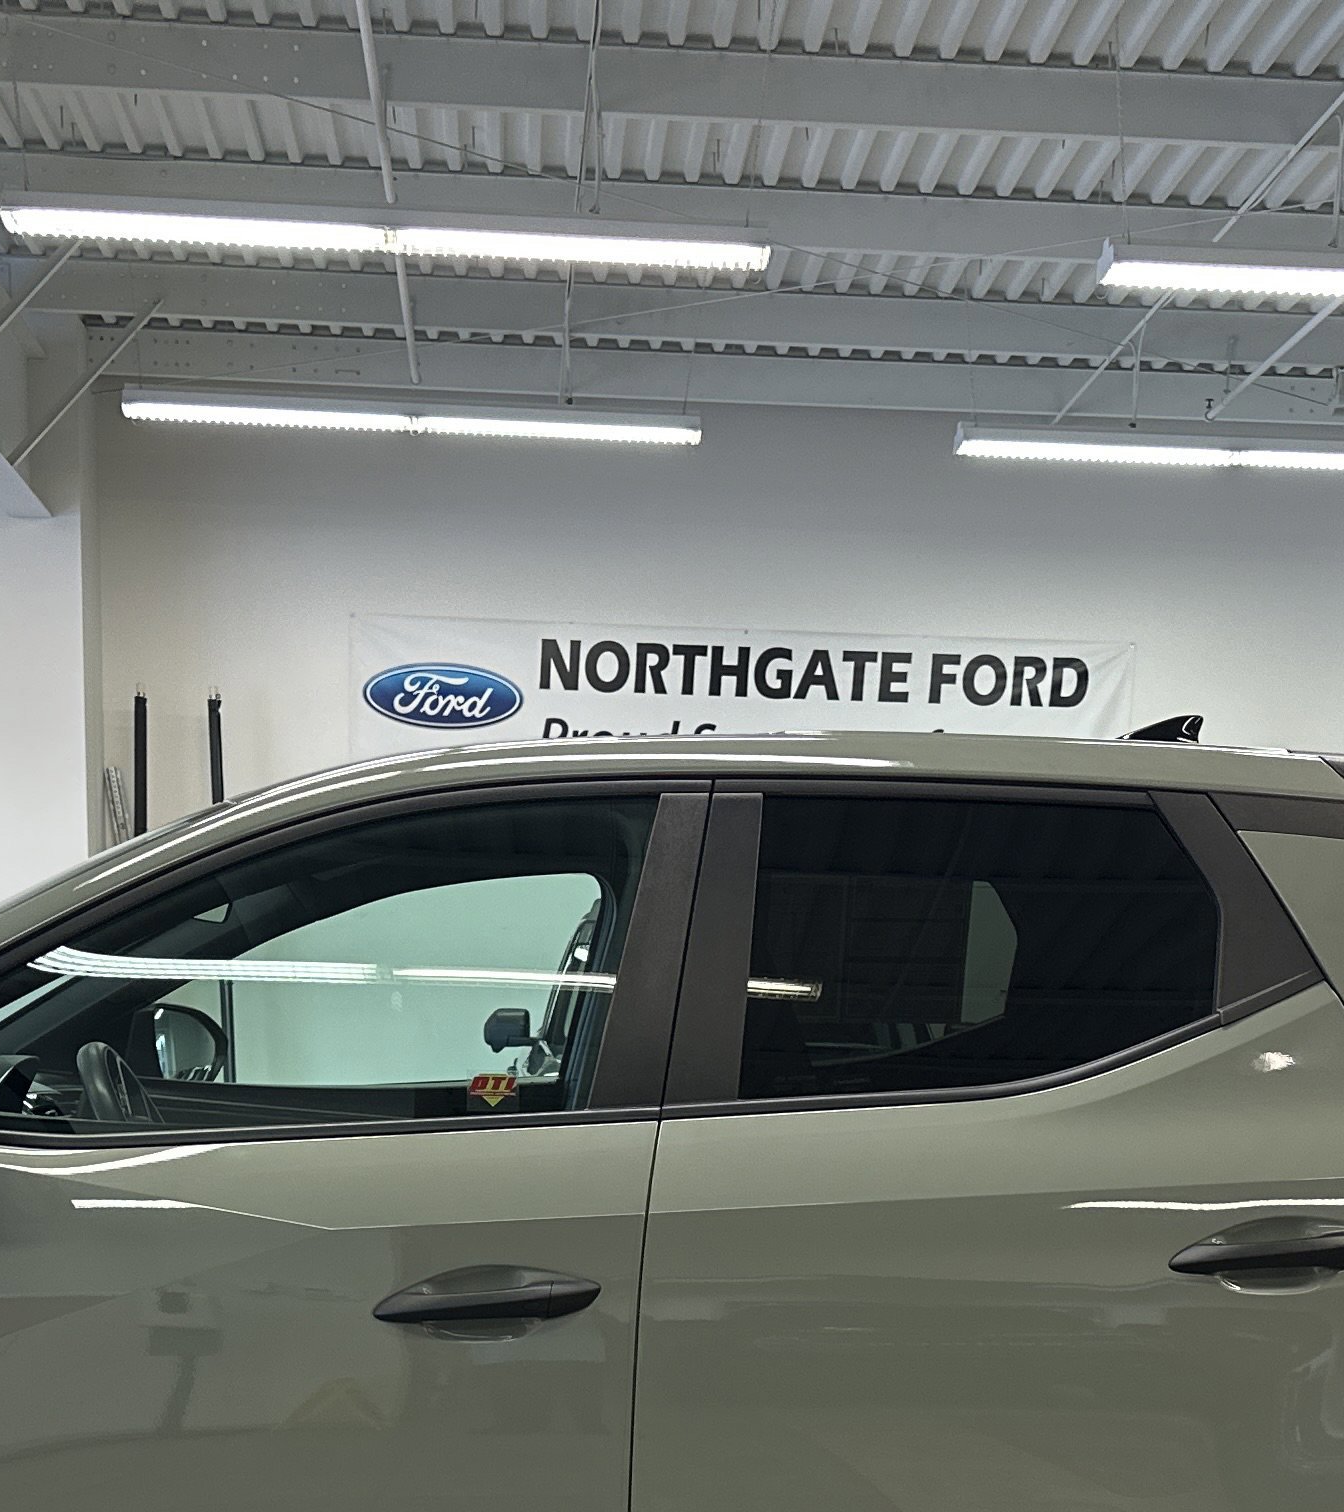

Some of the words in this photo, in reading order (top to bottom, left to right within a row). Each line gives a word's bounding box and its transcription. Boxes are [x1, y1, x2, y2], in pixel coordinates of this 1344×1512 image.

[393, 671, 494, 719] Ford
[539, 638, 913, 704] NORTHGATE
[928, 653, 1089, 708] FORD
